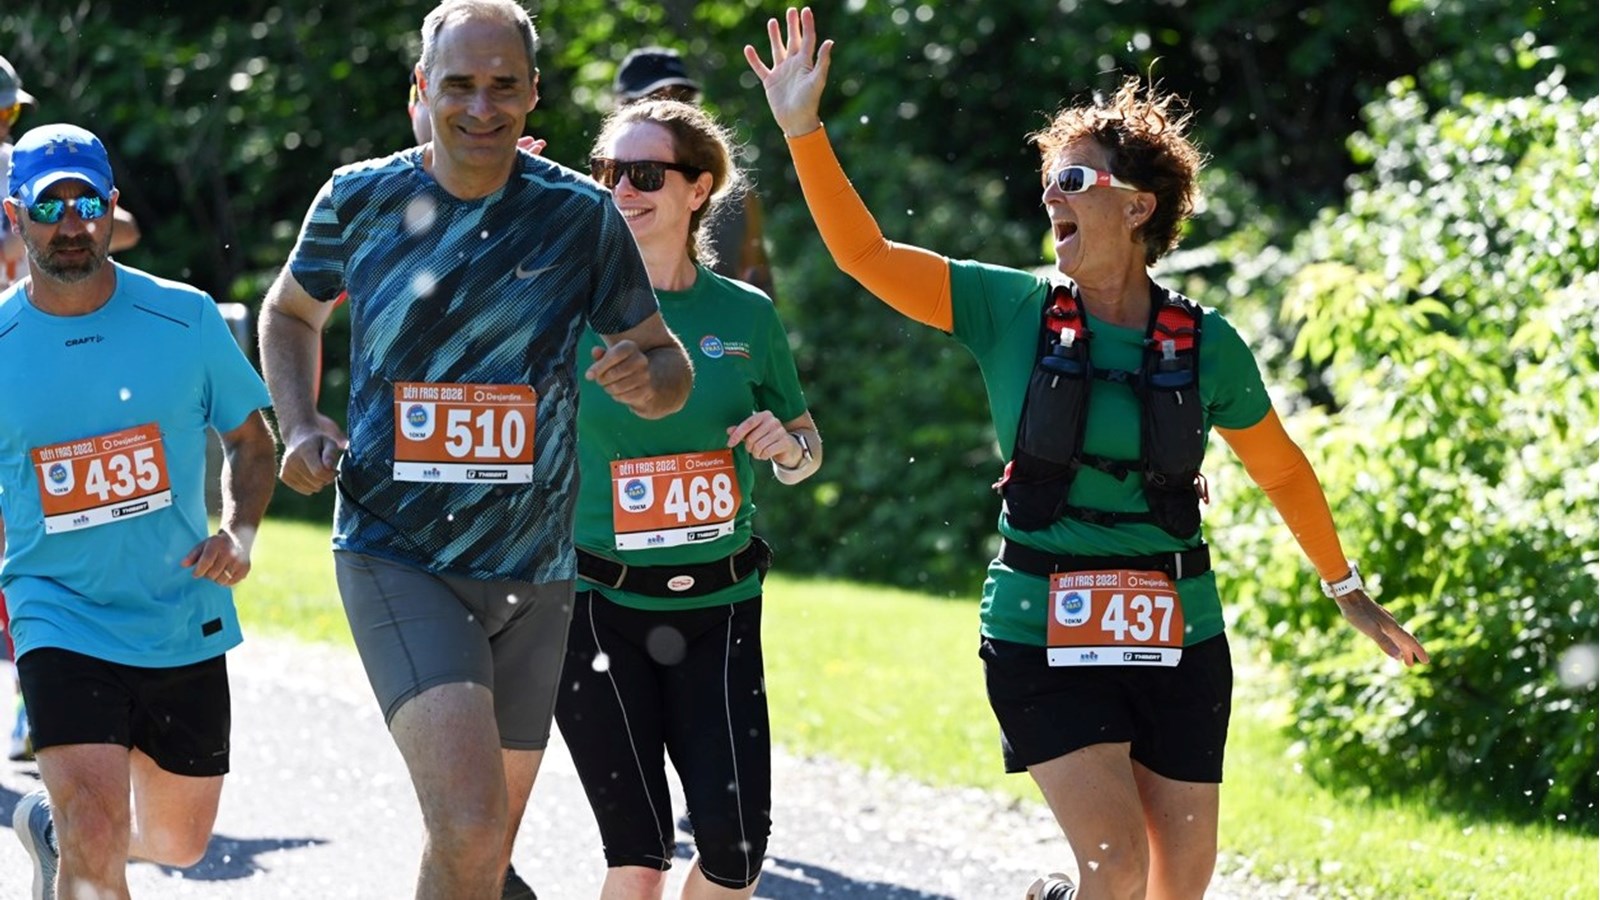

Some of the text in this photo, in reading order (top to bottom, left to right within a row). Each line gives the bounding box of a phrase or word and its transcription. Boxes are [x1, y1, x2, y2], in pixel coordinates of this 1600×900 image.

[403, 384, 463, 400] DÉFI FRAS 2022
[486, 393, 521, 402] Desjardins
[113, 434, 147, 447] Desjardins
[444, 408, 526, 459] 510
[39, 442, 94, 462] DÉFI FRAS 2022
[620, 460, 677, 476] DÉFI FRAS 2022
[696, 459, 724, 467] Desjardins
[85, 447, 160, 501] 435
[664, 473, 735, 523] 468
[1059, 573, 1118, 588] DÉFI FRAS 2022
[1139, 579, 1169, 587] Desjardins
[1101, 594, 1175, 642] 437
